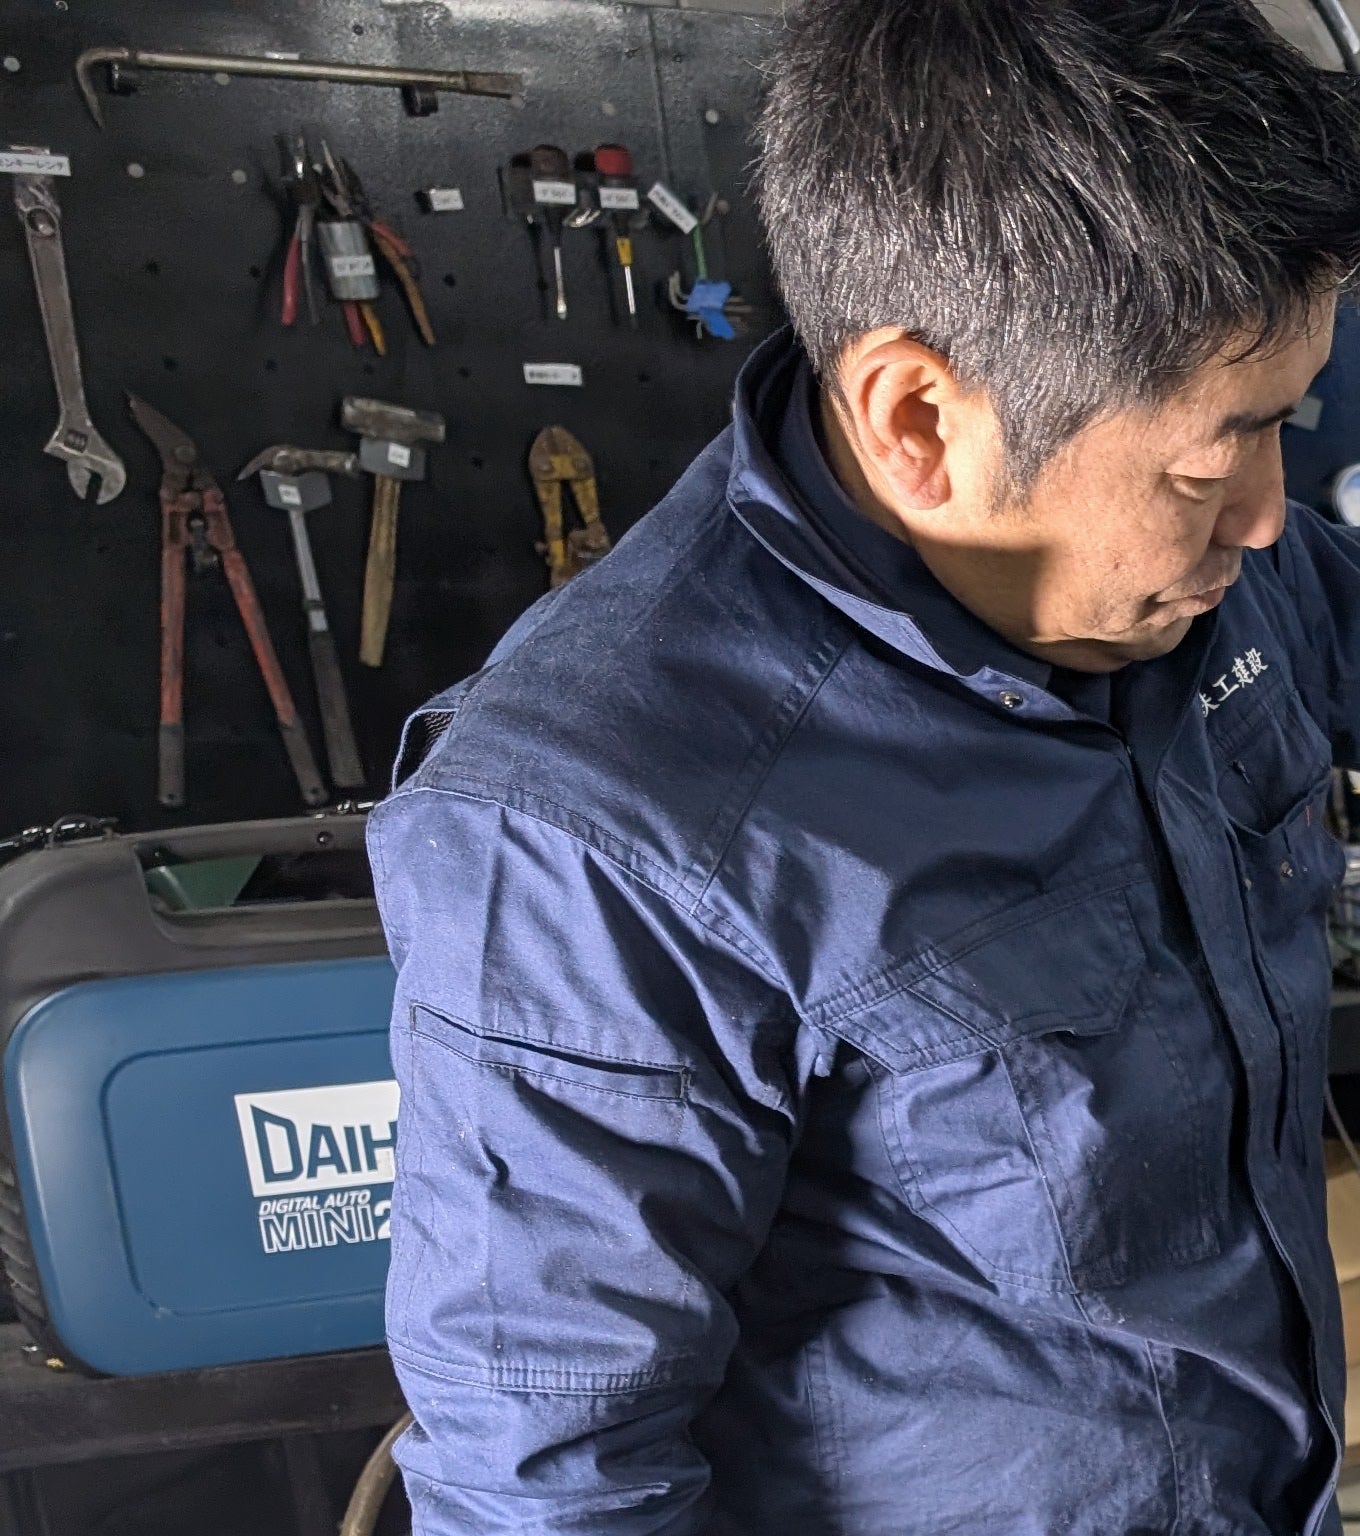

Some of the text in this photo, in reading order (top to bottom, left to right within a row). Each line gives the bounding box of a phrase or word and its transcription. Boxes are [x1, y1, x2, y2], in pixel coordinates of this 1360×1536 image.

[250, 1104, 398, 1184] DAIH
[259, 1189, 371, 1216] DIGITAL AUTO
